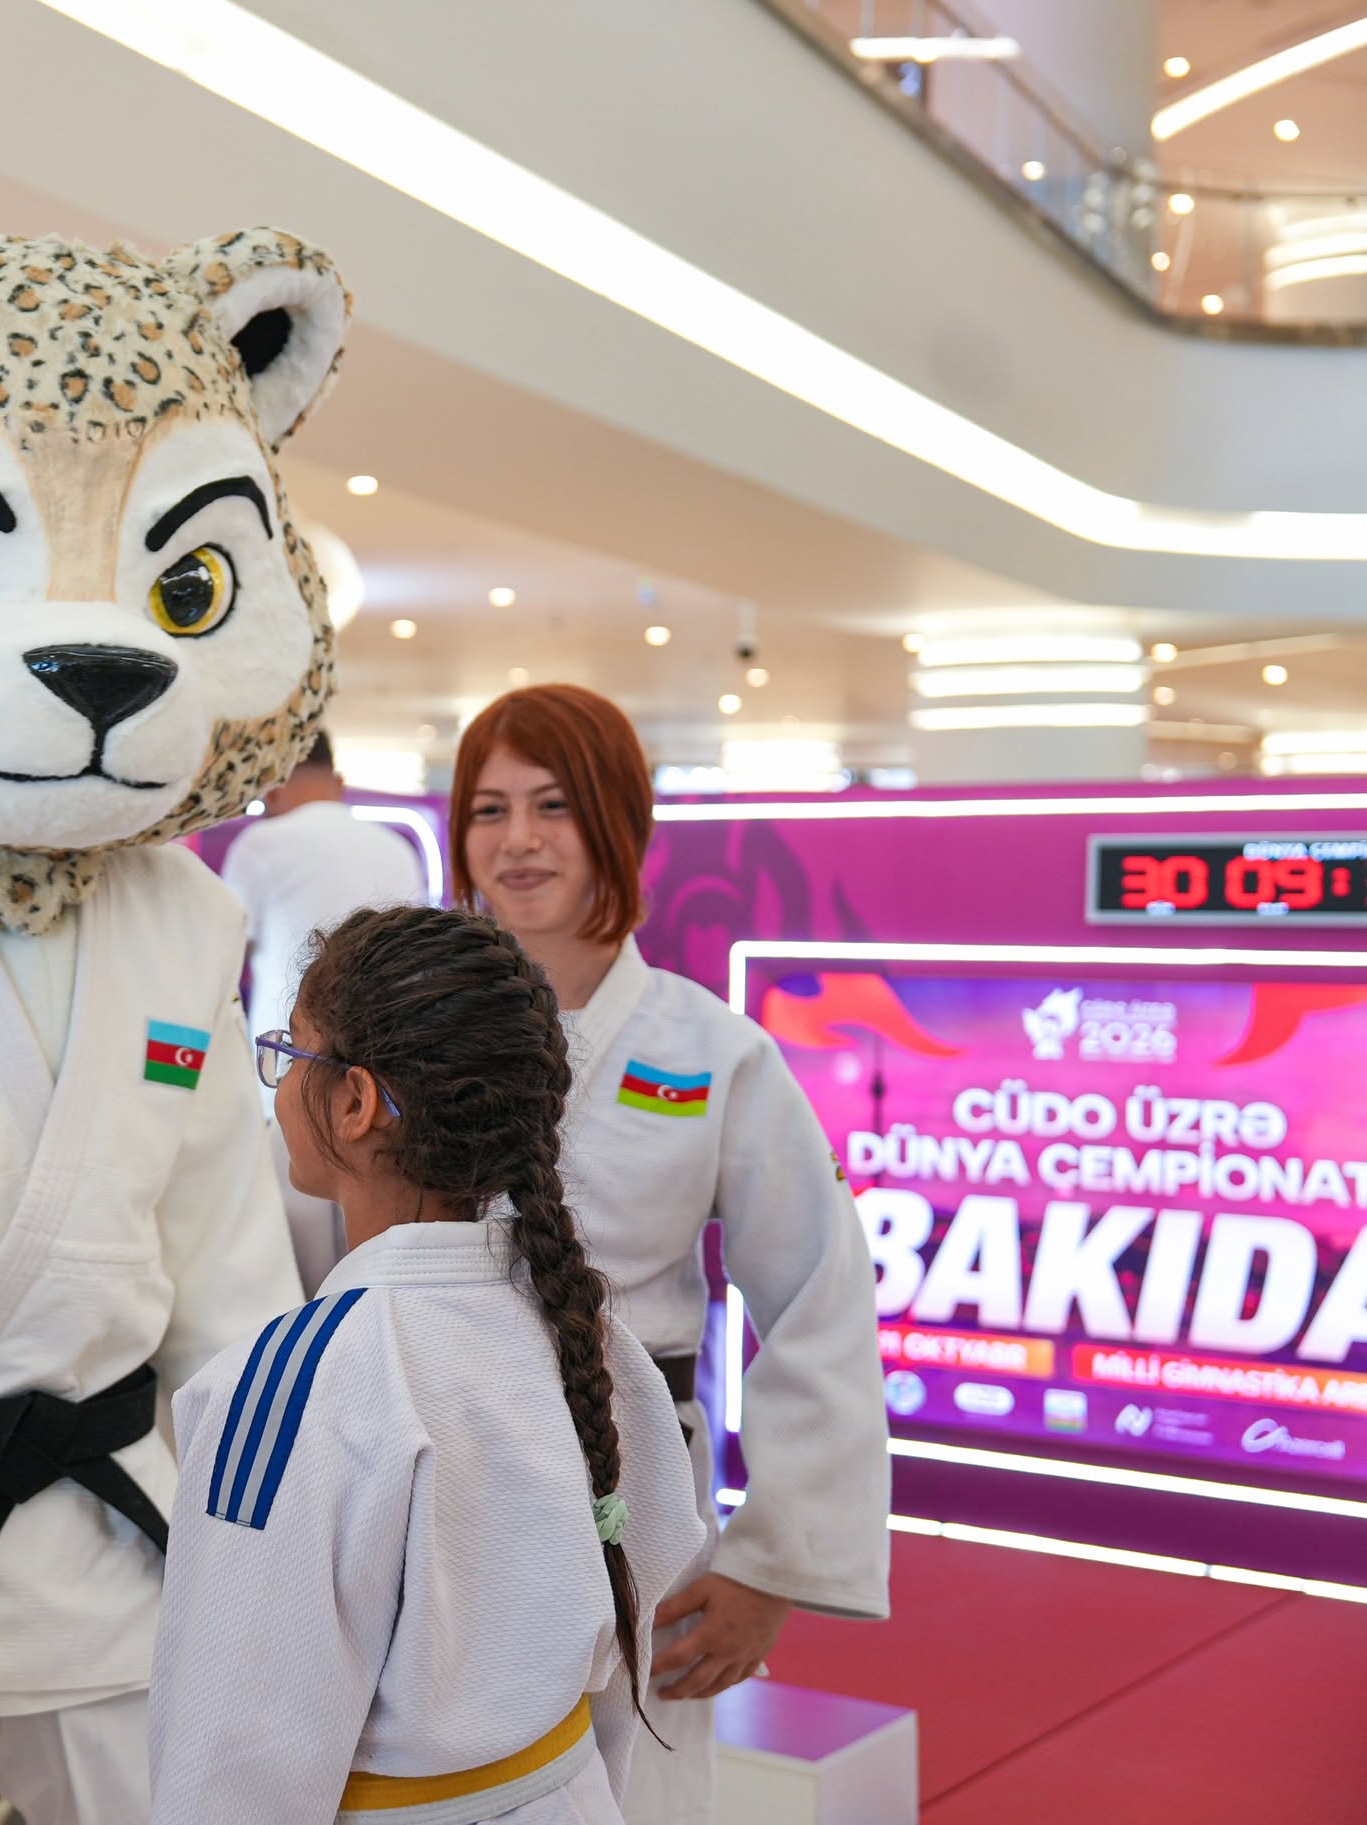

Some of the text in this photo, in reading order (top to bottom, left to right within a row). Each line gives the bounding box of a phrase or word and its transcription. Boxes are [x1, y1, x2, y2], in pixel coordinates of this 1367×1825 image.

[1122, 855, 1209, 909] 30
[953, 1079, 1288, 1150] CÜDO ÜZRƏ
[847, 1123, 1030, 1185] DÜNYA
